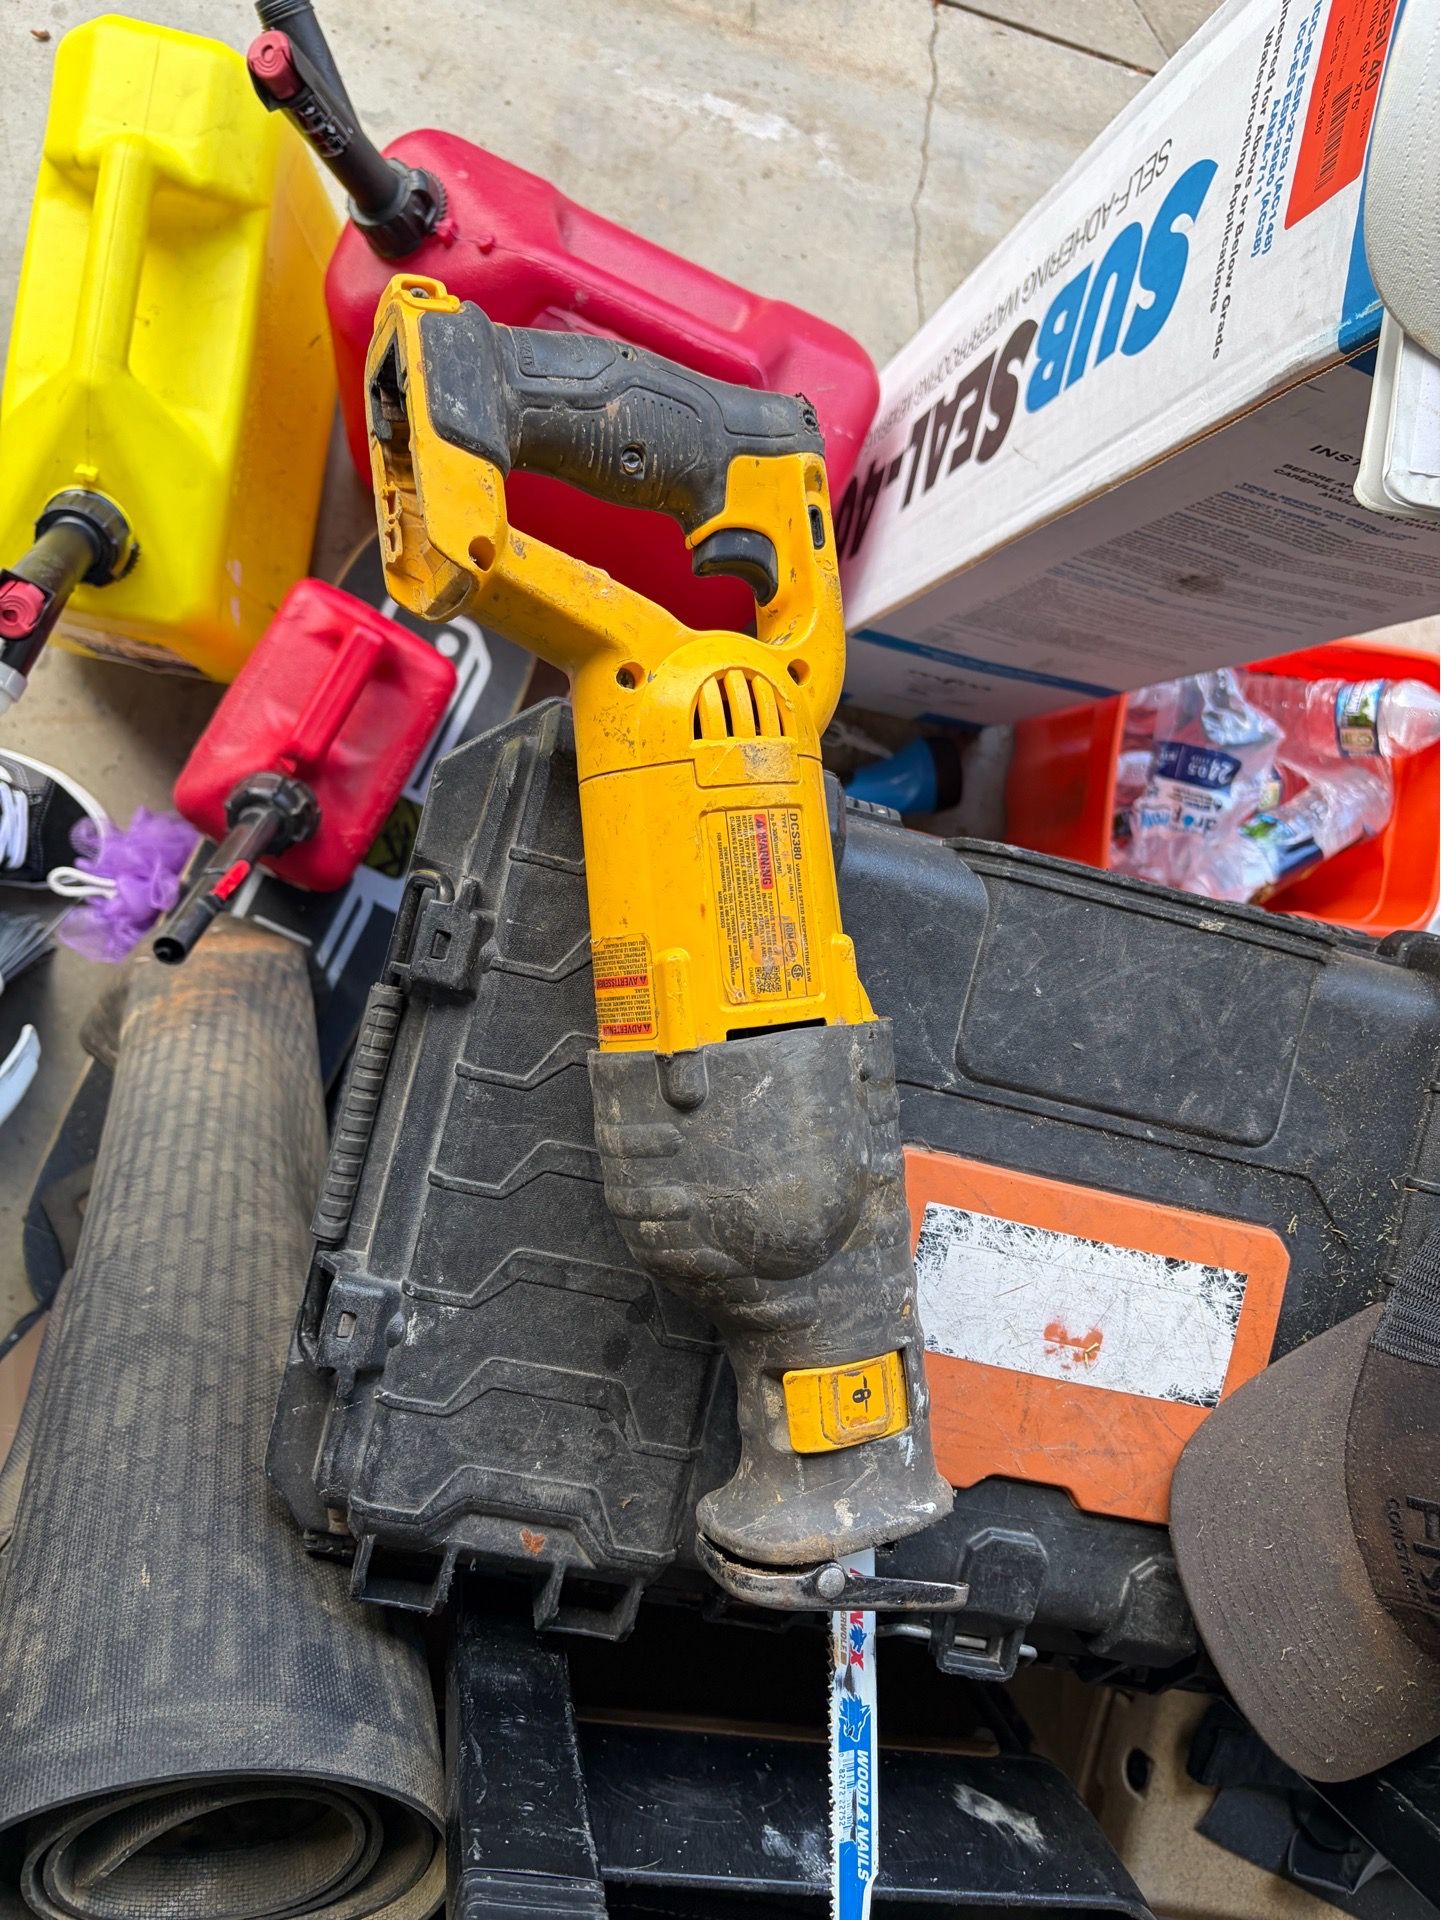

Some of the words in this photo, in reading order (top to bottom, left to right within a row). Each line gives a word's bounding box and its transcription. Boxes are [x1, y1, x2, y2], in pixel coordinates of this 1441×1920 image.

[1285, 16, 1309, 88] ICC-ES
[1360, 41, 1373, 59] of
[1362, 59, 1382, 91] 40
[1233, 25, 1275, 177] Waterproofing
[1258, 84, 1273, 116] for
[1278, 72, 1306, 171] ESR-2783
[1253, 98, 1281, 197] AAMA-711
[1264, 89, 1293, 187] ESR-3980
[1243, 123, 1265, 188] Above
[1238, 194, 1249, 215] or
[1259, 174, 1286, 255] (AC148)
[1249, 191, 1272, 258] (AC38)
[1206, 183, 1242, 314] Applications
[1223, 220, 1245, 287] Below
[1211, 293, 1232, 360] Grade
[1282, 463, 1336, 484] BEFORE
[716, 841, 724, 860] SERVICE
[788, 812, 803, 860] DCS380
[731, 845, 740, 867] BLADES
[734, 867, 741, 875] OR
[746, 814, 756, 850] INSTRCTION
[753, 877, 762, 900] ALWAYS
[734, 876, 743, 898] MAKING
[740, 869, 749, 892] REMOVE
[794, 862, 802, 893] VARIABLE
[742, 893, 751, 917] BATTERY
[748, 886, 757, 910] ALWAYS
[797, 894, 805, 915] SPEED
[718, 910, 726, 928] MEXICO
[799, 915, 811, 966] RECIPROCATING
[838, 1767, 846, 1796] 82472
[856, 1749, 869, 1806] WOOD
[856, 1805, 869, 1823] &
[856, 1823, 869, 1882] NAILS
